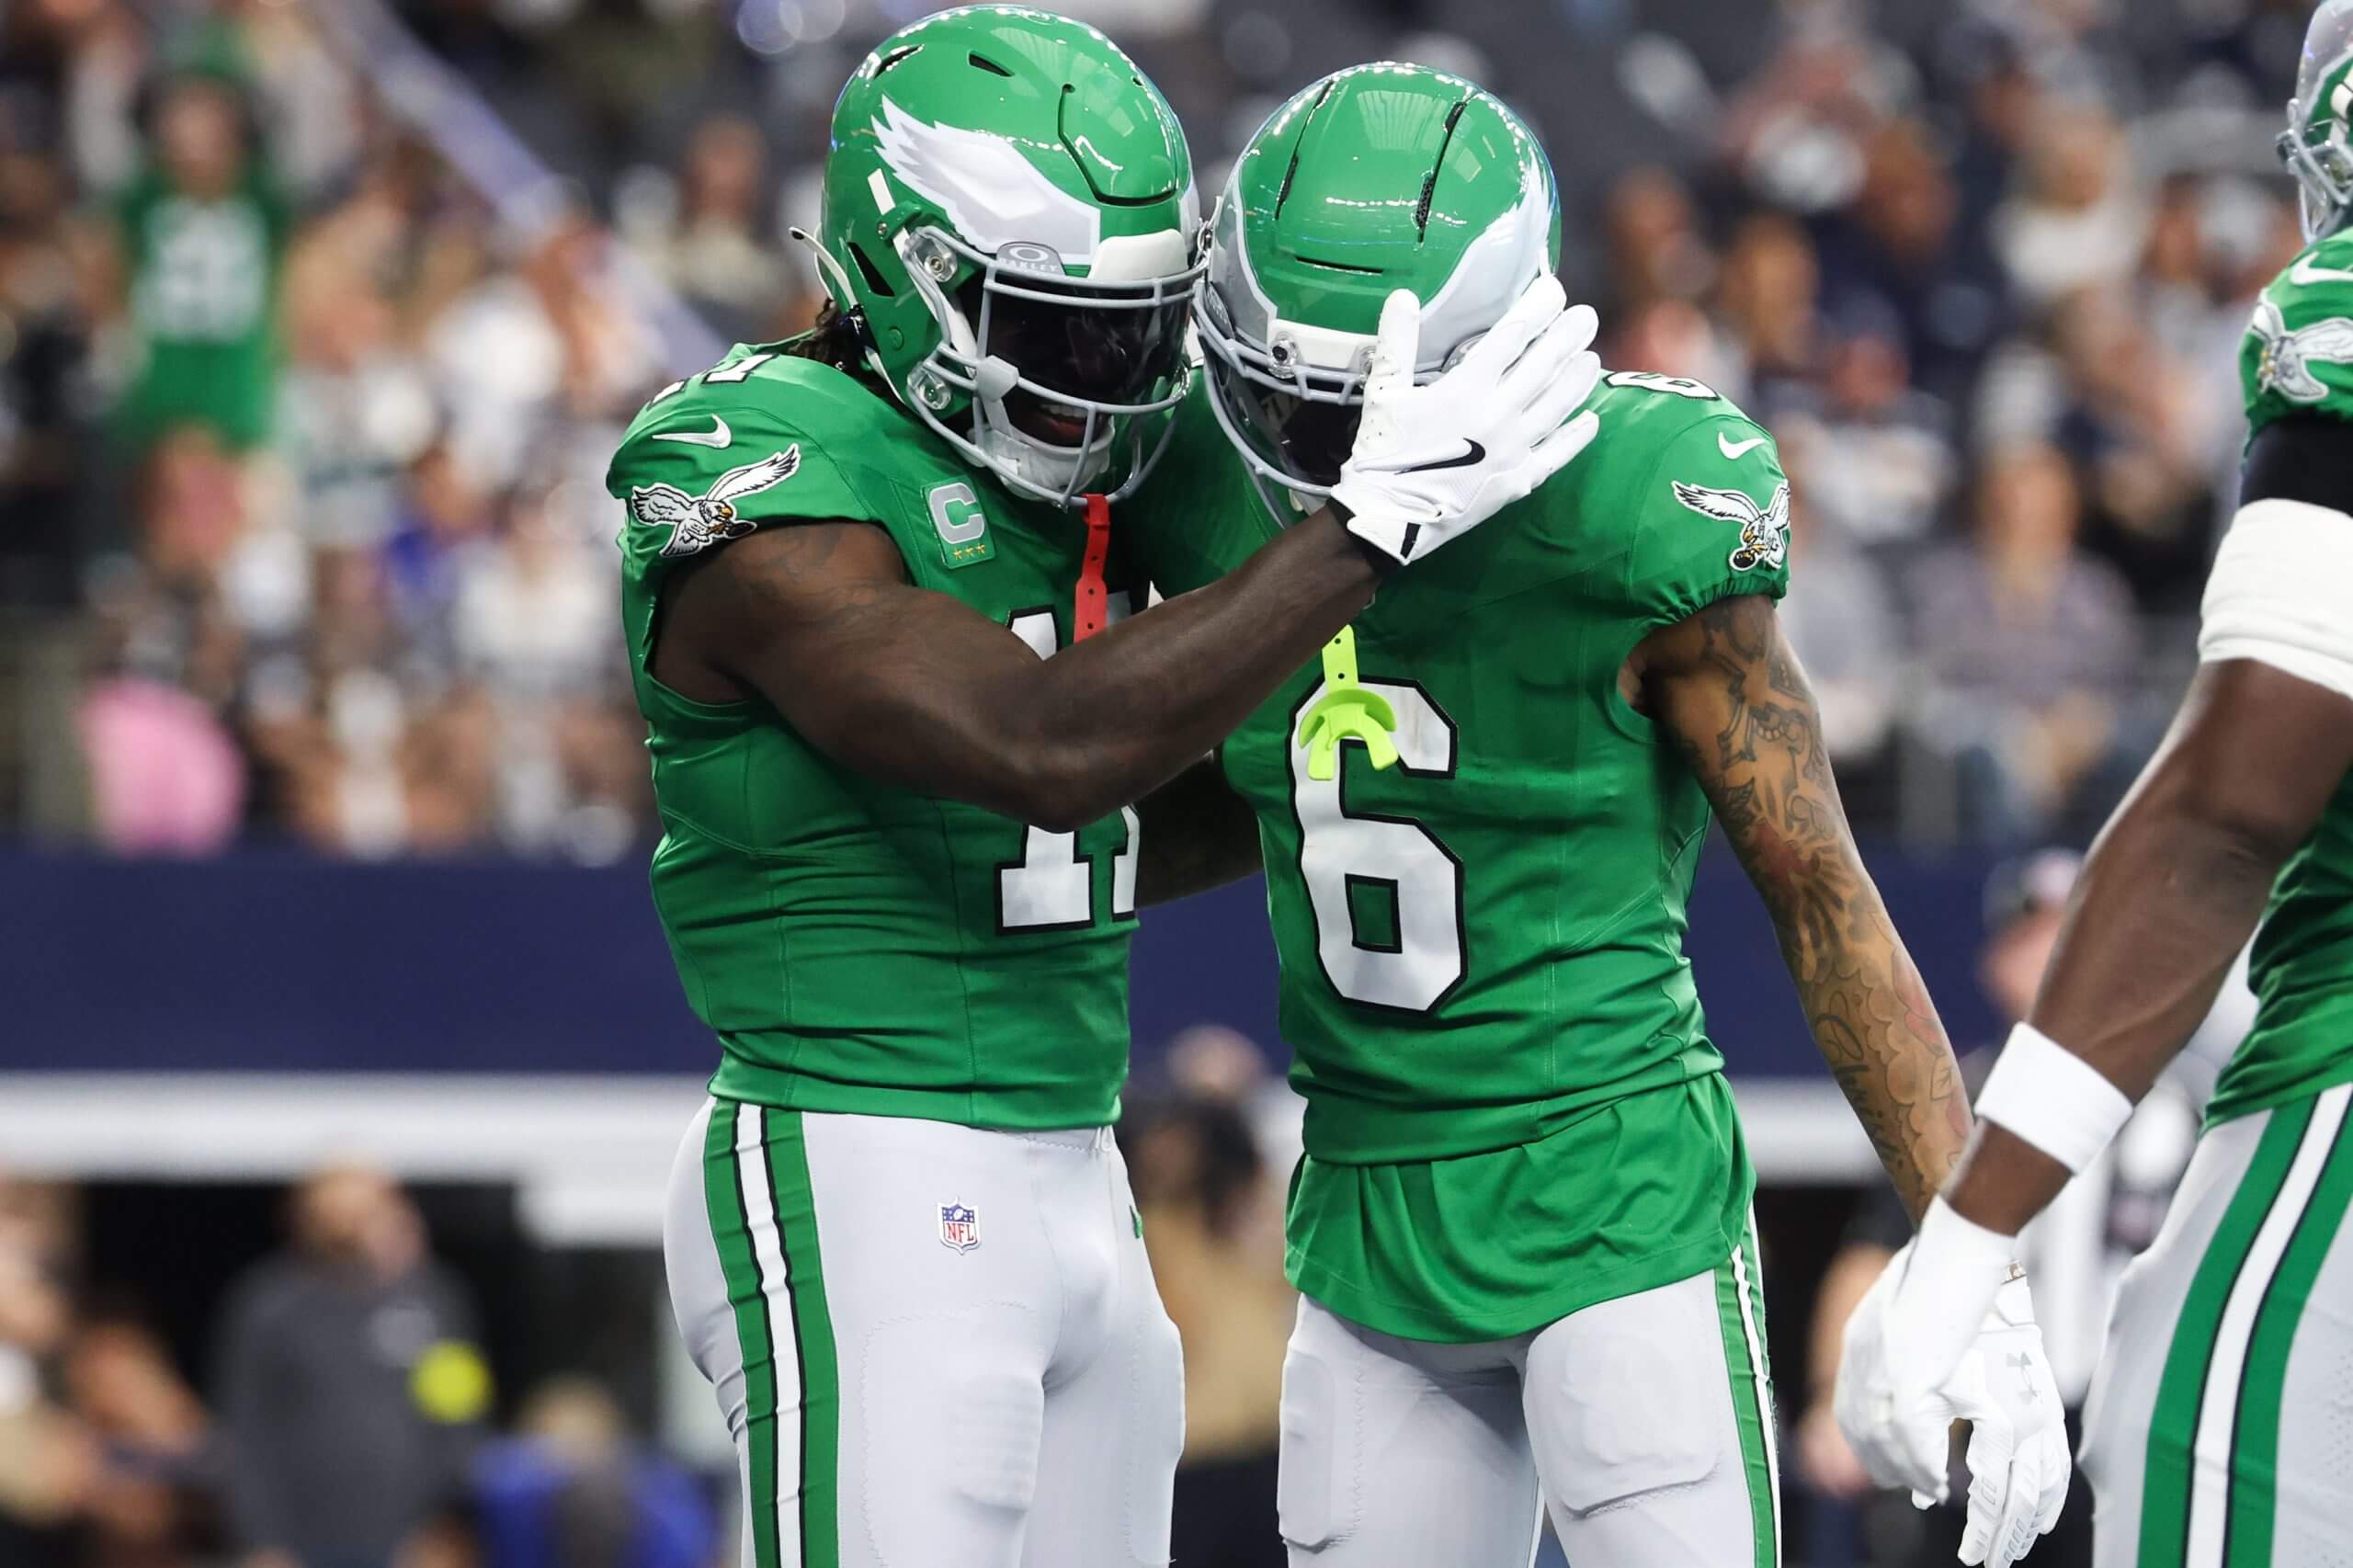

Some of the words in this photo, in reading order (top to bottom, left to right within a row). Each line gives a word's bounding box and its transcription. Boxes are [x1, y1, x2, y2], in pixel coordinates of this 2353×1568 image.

[929, 483, 984, 544] C
[1287, 676, 1468, 1014] 6
[947, 1221, 974, 1243] NFL
